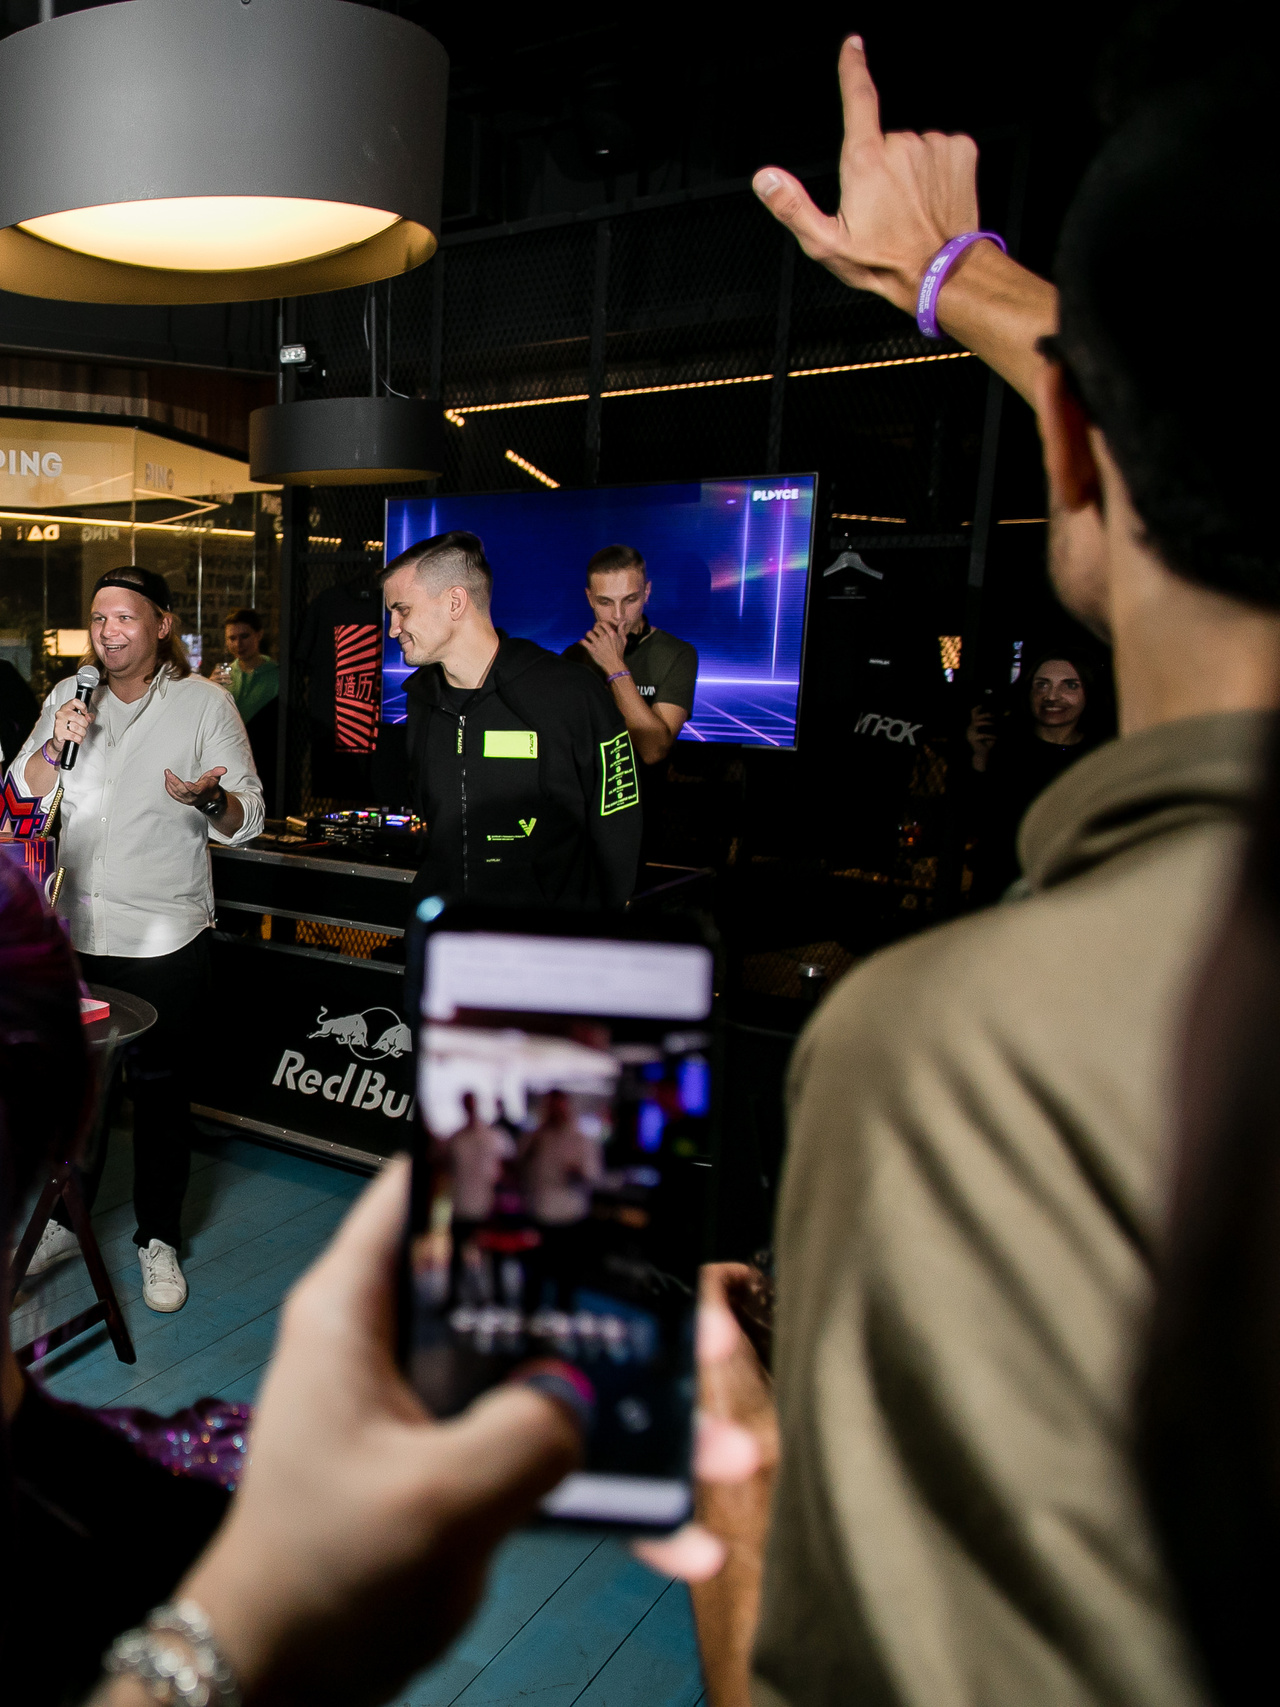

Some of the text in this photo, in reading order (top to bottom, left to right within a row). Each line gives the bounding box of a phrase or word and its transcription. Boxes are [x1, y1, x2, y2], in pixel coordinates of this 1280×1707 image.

[853, 711, 924, 747] ИГРОК
[272, 1049, 415, 1122] Red Bu
